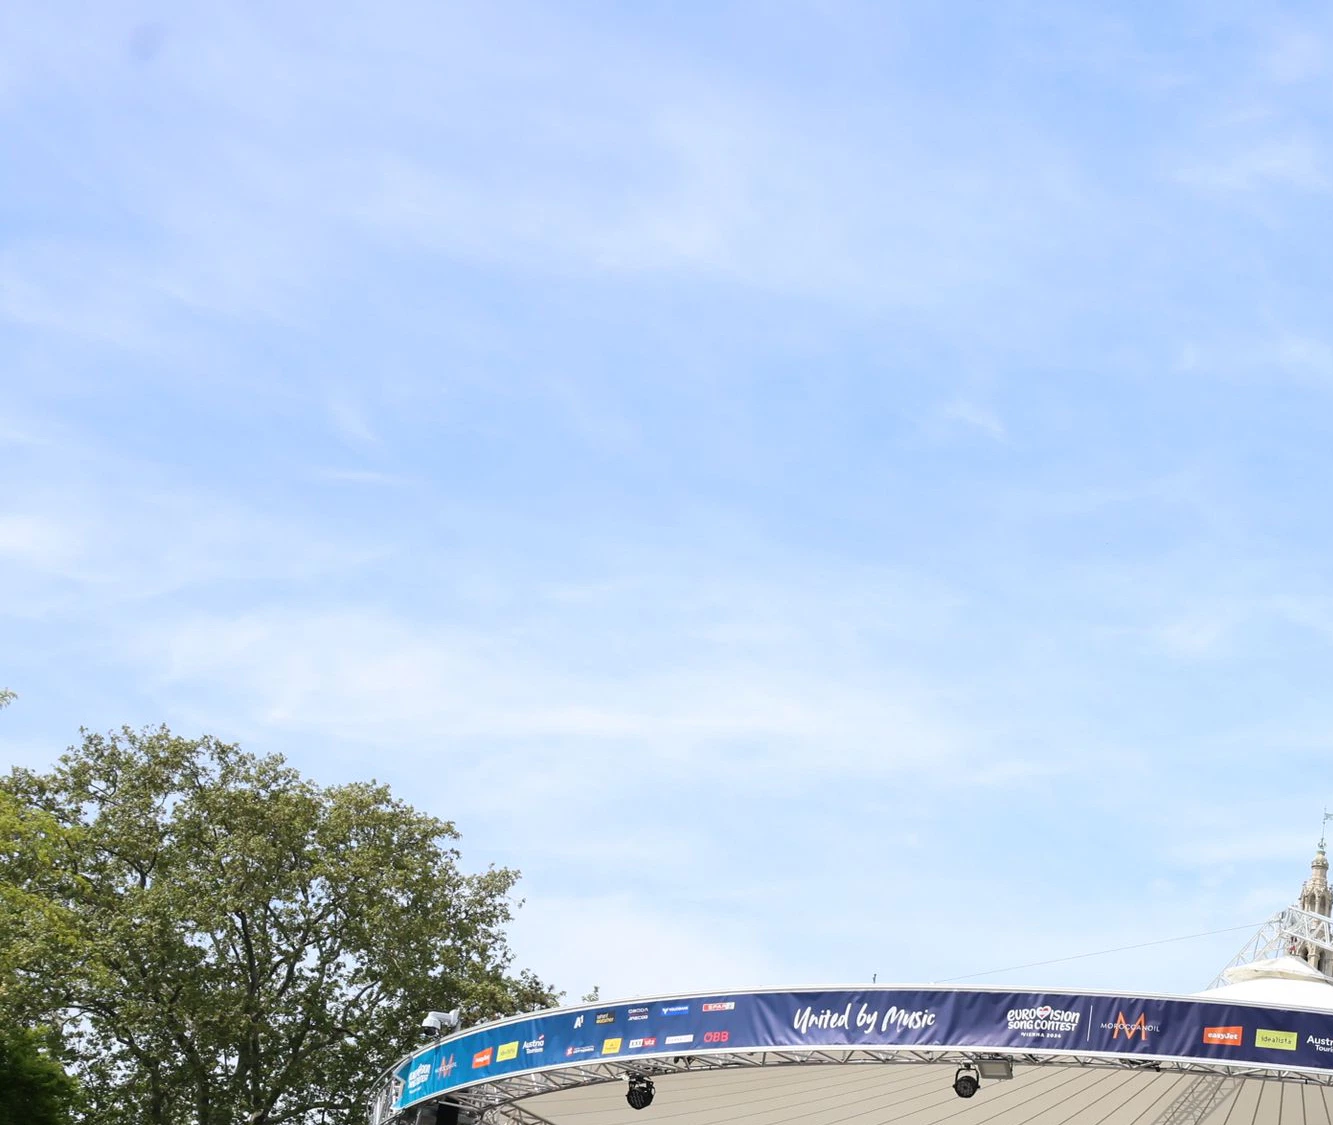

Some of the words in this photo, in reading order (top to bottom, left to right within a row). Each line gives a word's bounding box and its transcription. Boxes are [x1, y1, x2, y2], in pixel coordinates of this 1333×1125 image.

[573, 1014, 584, 1029] A1
[793, 1003, 852, 1034] United
[856, 1003, 878, 1034] by
[881, 1006, 936, 1033] Music
[1008, 1019, 1034, 1030] SONG
[1034, 1020, 1077, 1032] CONTEST
[1100, 1022, 1160, 1033] MOROCCANOIL
[1207, 1031, 1239, 1041] easyJet
[1260, 1035, 1292, 1046] idealista
[522, 1039, 545, 1050] Austria
